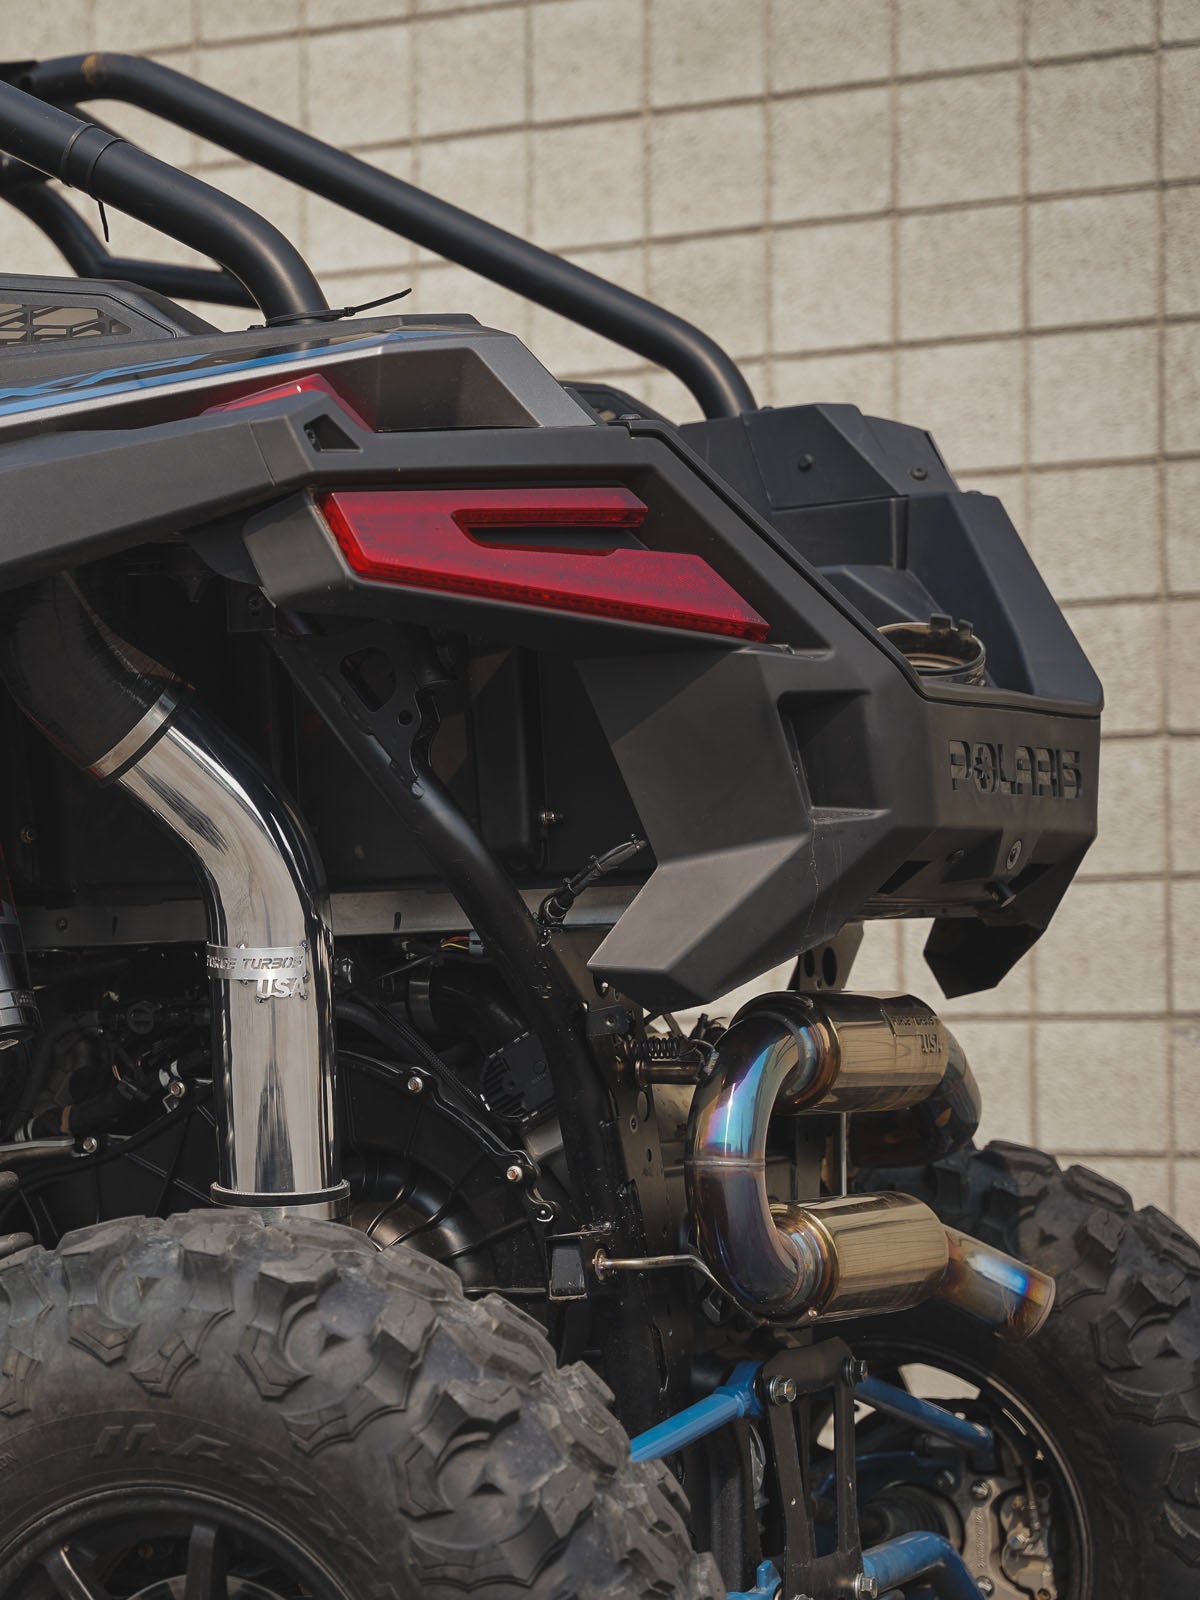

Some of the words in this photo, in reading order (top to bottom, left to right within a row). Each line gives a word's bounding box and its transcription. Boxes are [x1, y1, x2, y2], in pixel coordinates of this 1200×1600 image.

[948, 739, 1083, 800] POLARIS
[242, 955, 304, 970] TURBOS
[256, 977, 306, 1001] USA
